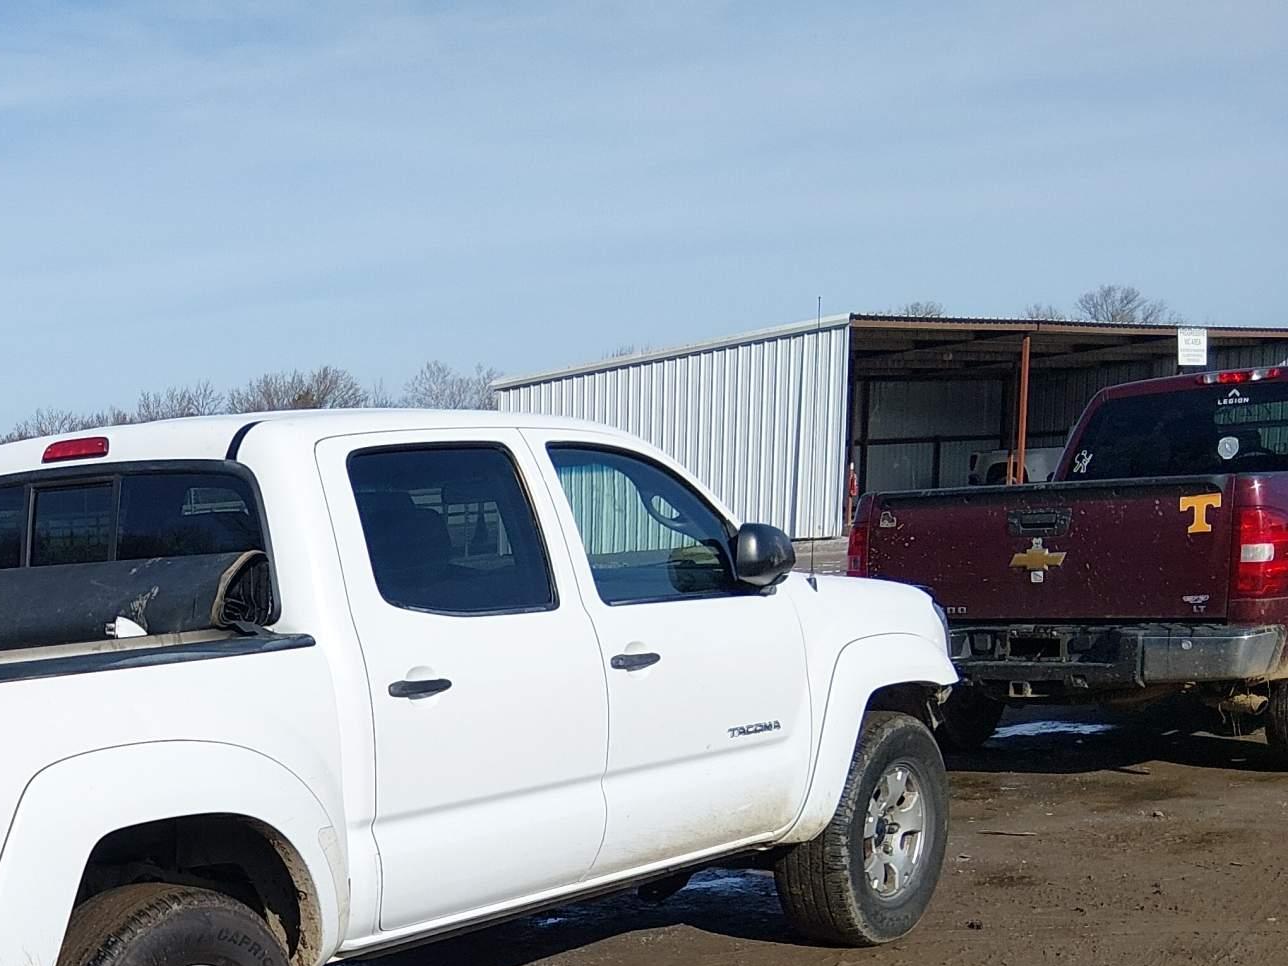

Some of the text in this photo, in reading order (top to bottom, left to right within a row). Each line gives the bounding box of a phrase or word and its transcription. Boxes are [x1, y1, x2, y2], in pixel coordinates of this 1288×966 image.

[1217, 397, 1249, 405] LEGION
[1179, 493, 1222, 534] T
[1193, 605, 1207, 613] LT
[727, 720, 781, 738] TACOMA
